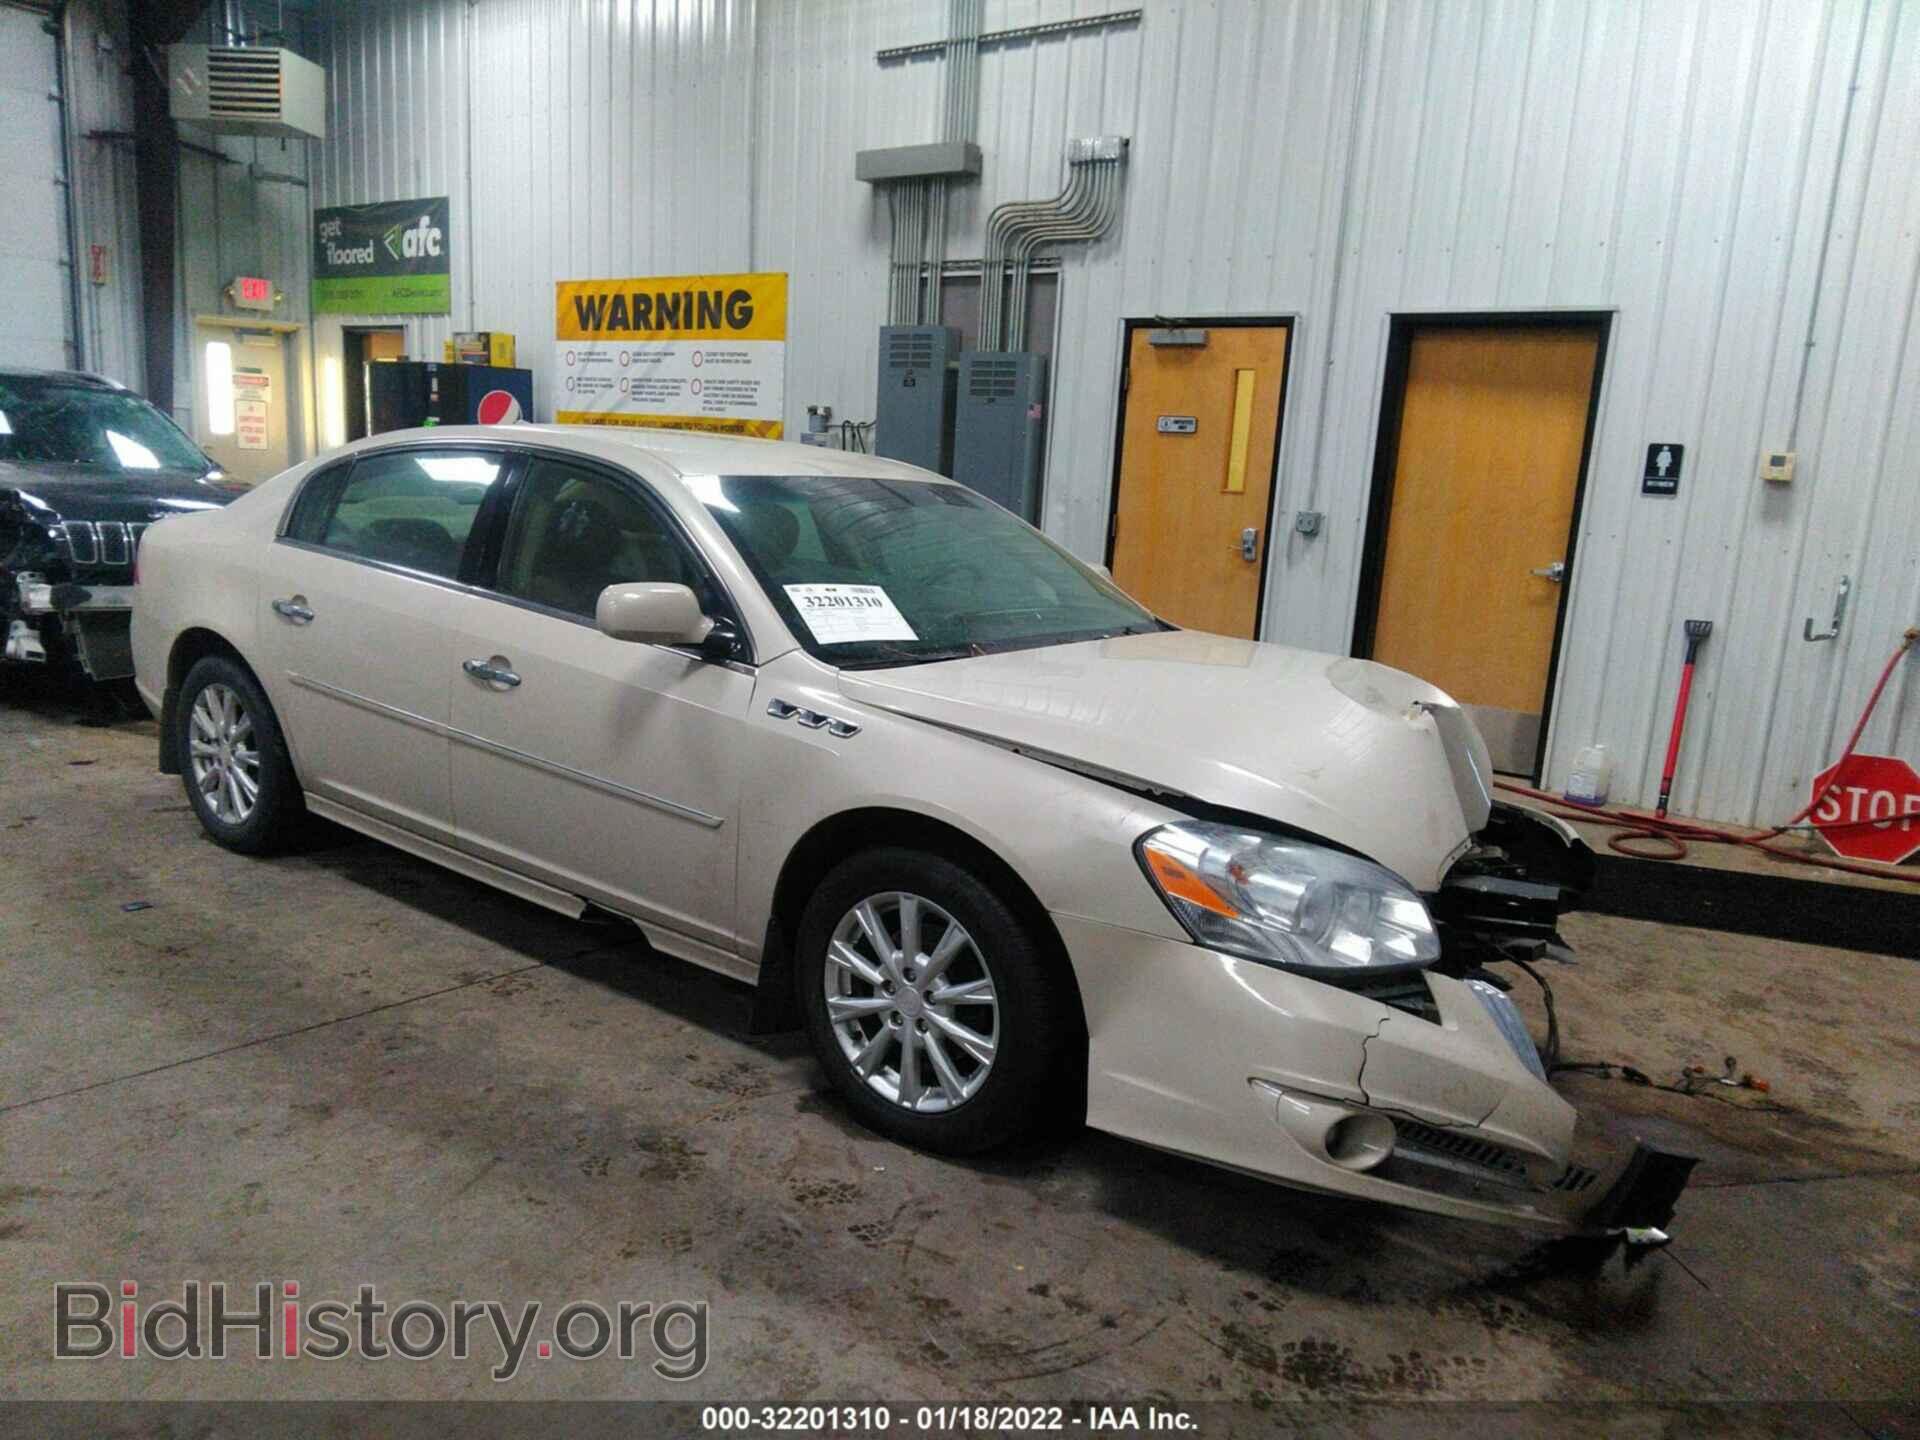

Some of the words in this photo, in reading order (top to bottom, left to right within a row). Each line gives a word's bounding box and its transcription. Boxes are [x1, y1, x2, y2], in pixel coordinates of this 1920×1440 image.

[326, 239, 375, 265] floored
[402, 215, 442, 258] afc
[574, 289, 754, 331] WARNING
[803, 596, 883, 608] 32201310
